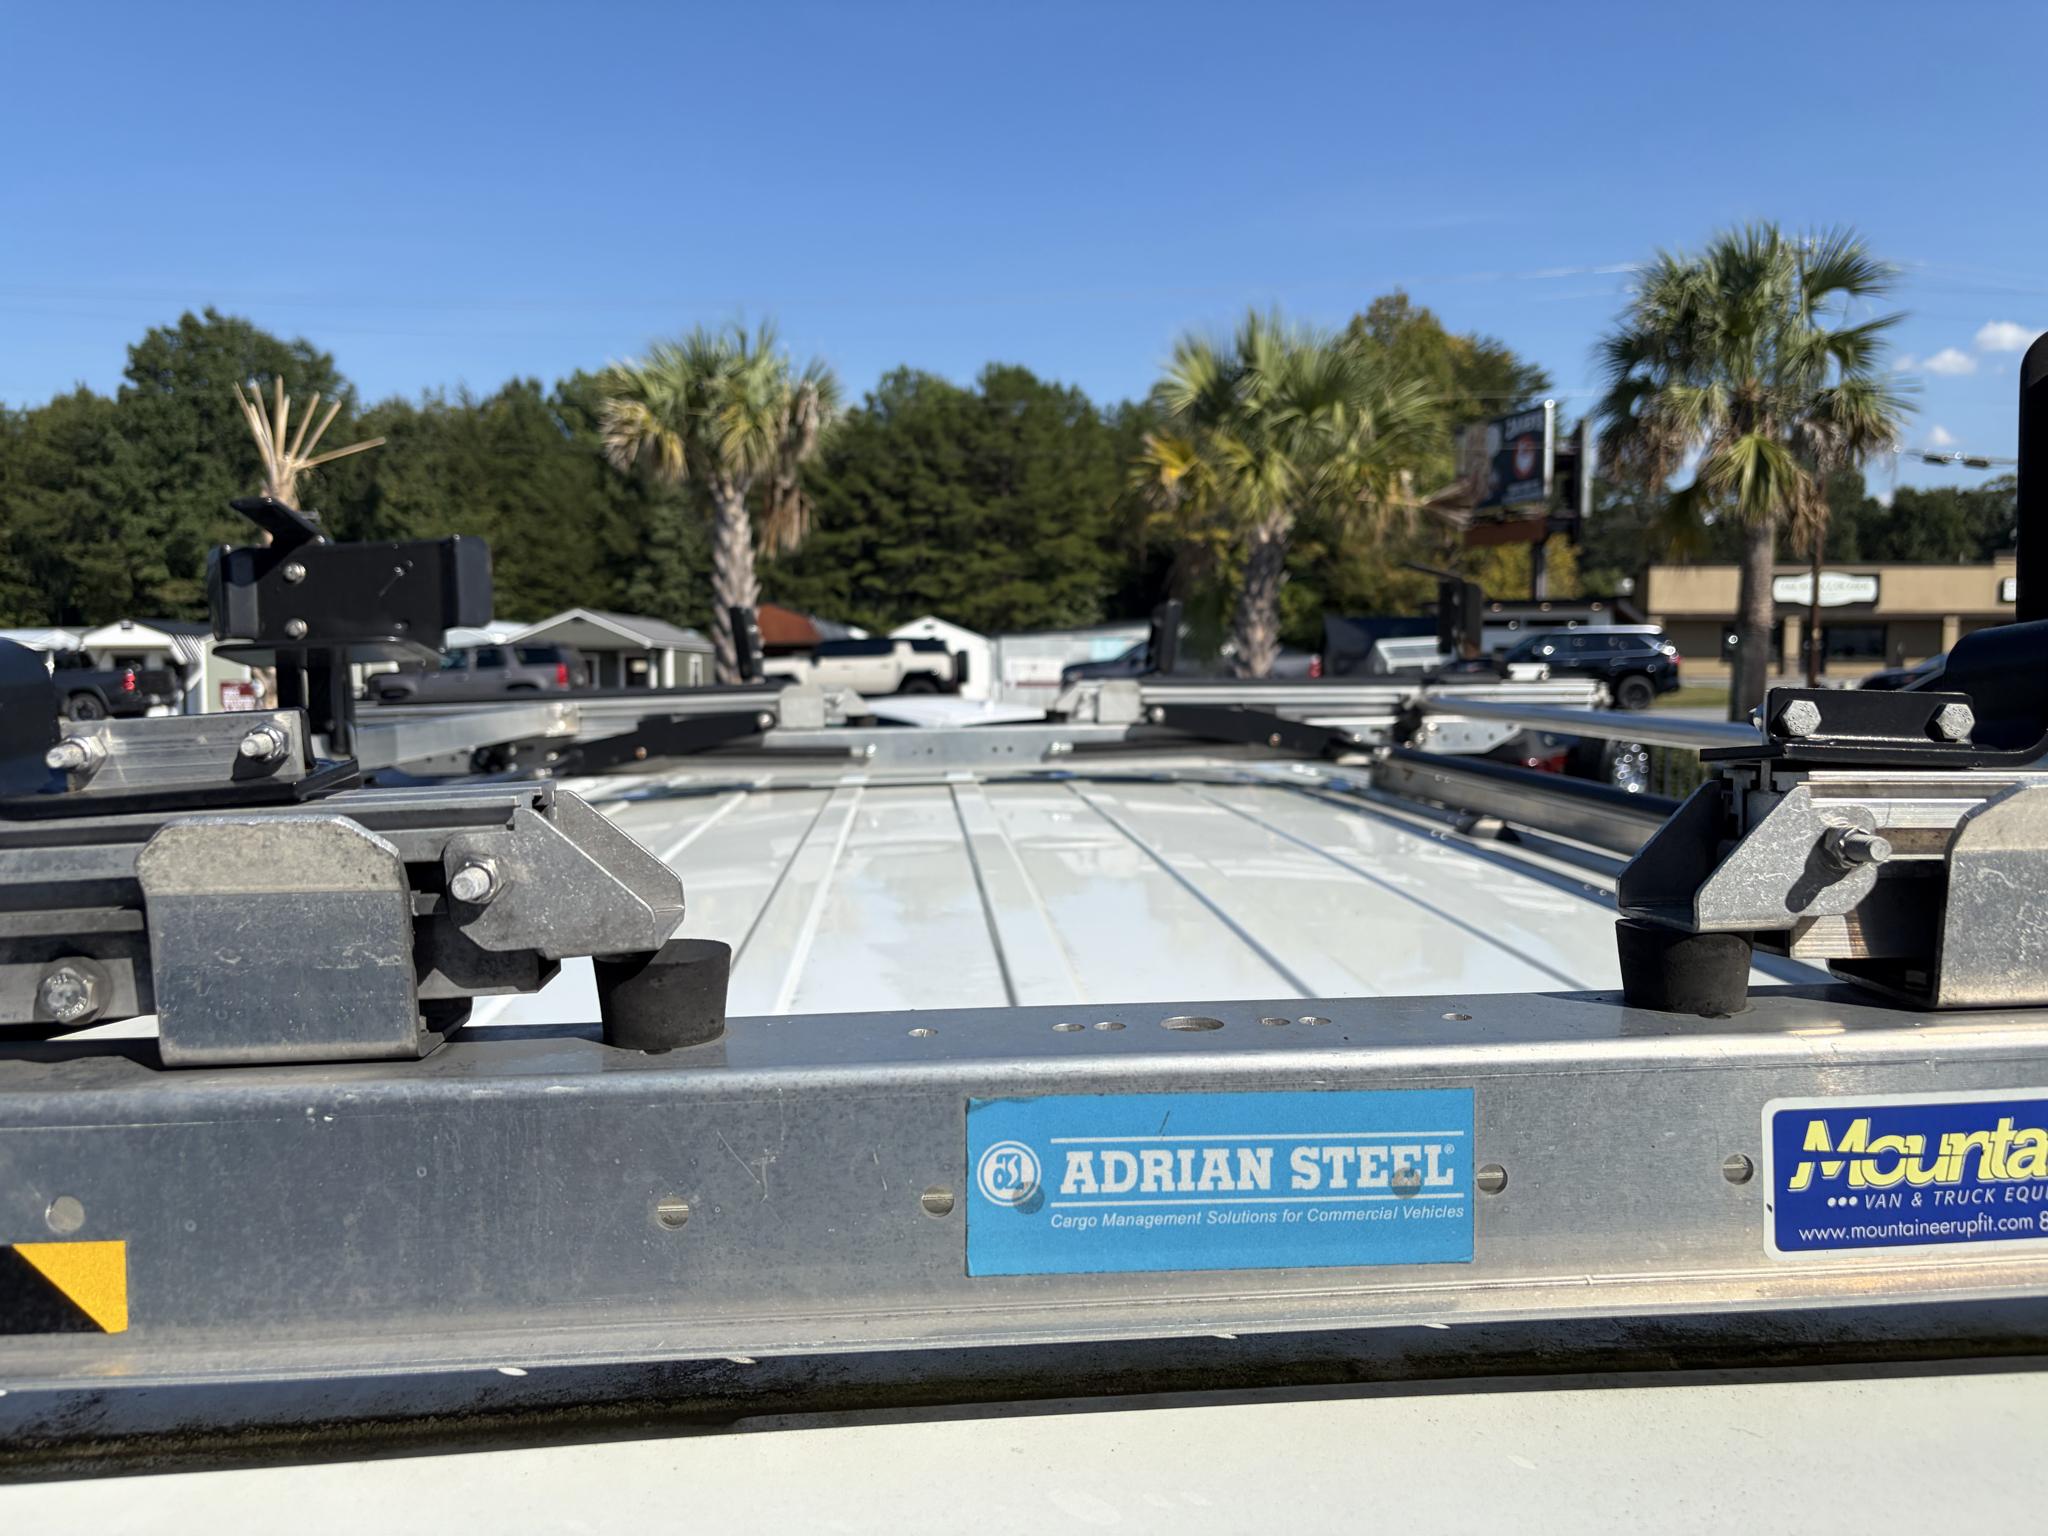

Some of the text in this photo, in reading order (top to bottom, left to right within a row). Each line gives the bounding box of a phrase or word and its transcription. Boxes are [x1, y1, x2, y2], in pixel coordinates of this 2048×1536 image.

[1059, 1147, 1274, 1195] ADRIAN
[1864, 1193, 1902, 1210] VAN
[1910, 1191, 1923, 1208] &
[1933, 1187, 1996, 1207] TRUCK
[1050, 1204, 1465, 1231] Cargo Management Solutions for Commercial Vehicles
[1799, 1211, 2034, 1241] www.mountaineerupfit.com
